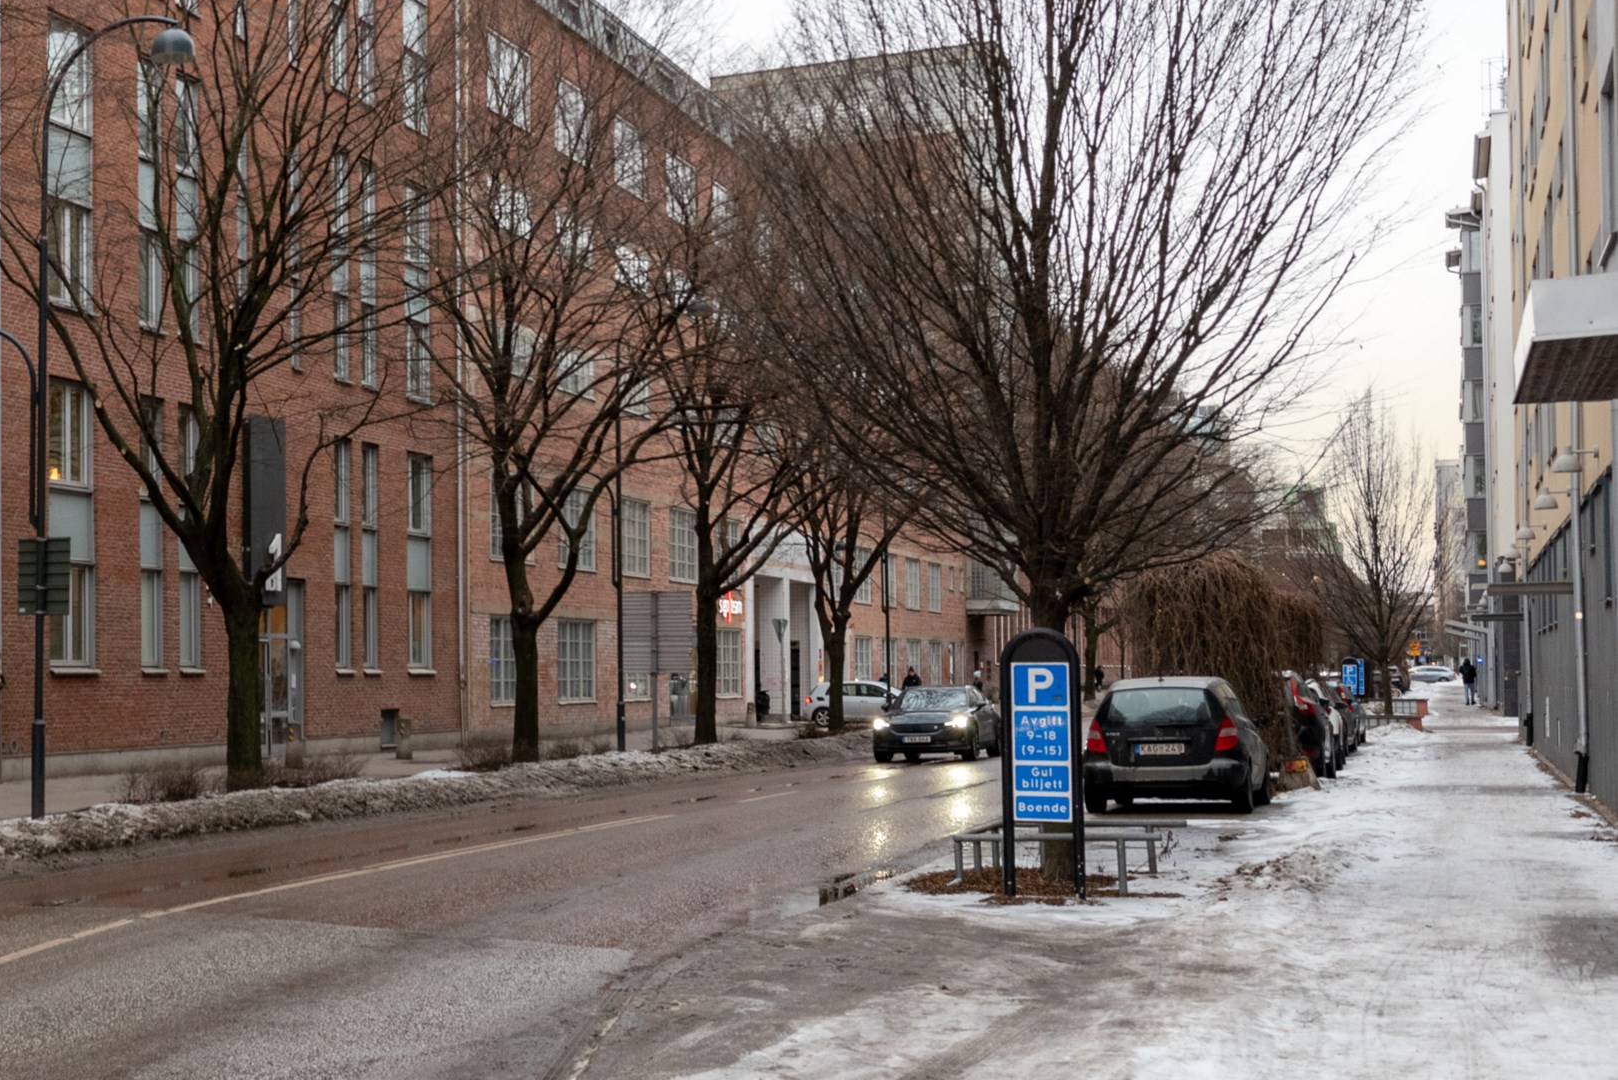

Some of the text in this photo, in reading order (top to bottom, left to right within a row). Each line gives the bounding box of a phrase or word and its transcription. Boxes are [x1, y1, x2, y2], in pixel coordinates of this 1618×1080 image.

[1027, 667, 1054, 704] P
[1021, 715, 1063, 728] Avgift
[1026, 730, 1057, 740] 9-18
[1021, 744, 1062, 757] (9-15)
[1031, 767, 1052, 777] Gul
[1022, 778, 1063, 791] biljett
[1018, 802, 1067, 813] Boende
